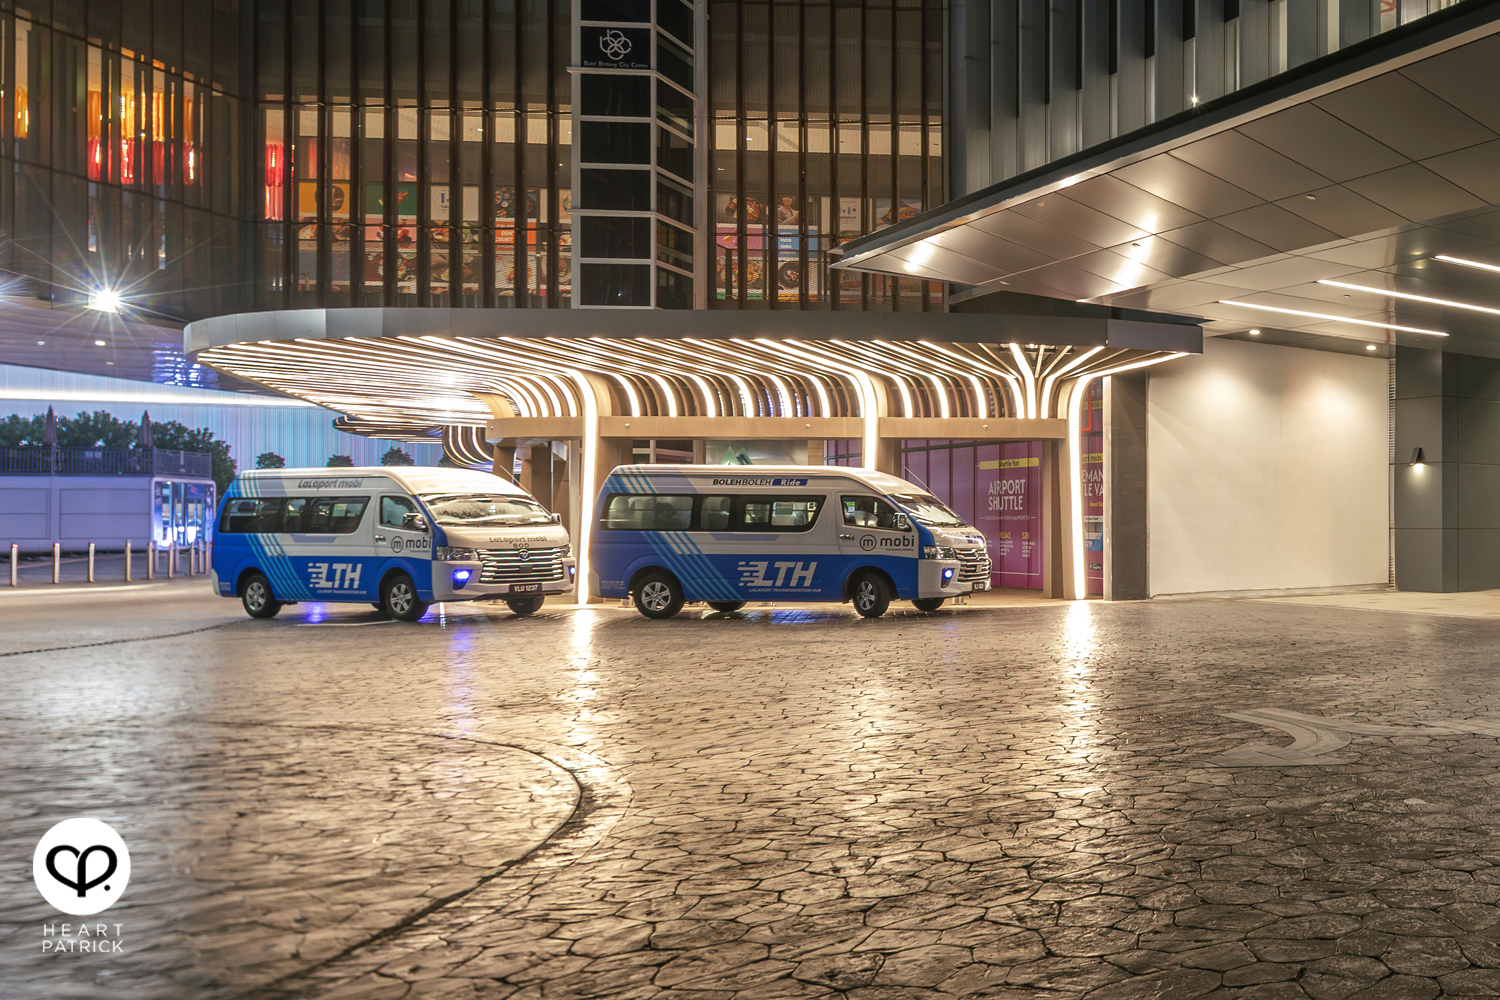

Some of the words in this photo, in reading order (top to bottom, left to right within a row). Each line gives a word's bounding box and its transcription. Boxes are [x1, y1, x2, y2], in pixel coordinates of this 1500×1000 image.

[780, 478, 801, 486] Ride
[1082, 469, 1103, 482] EMAN
[298, 479, 338, 491] LaLaport
[338, 477, 364, 488] mobi
[988, 479, 1026, 495] AIRPORT
[988, 495, 1024, 511] SHUTTLE
[405, 536, 432, 549] mobi
[880, 535, 915, 547] mobi
[309, 563, 363, 589] LTH
[739, 561, 818, 587] LTH
